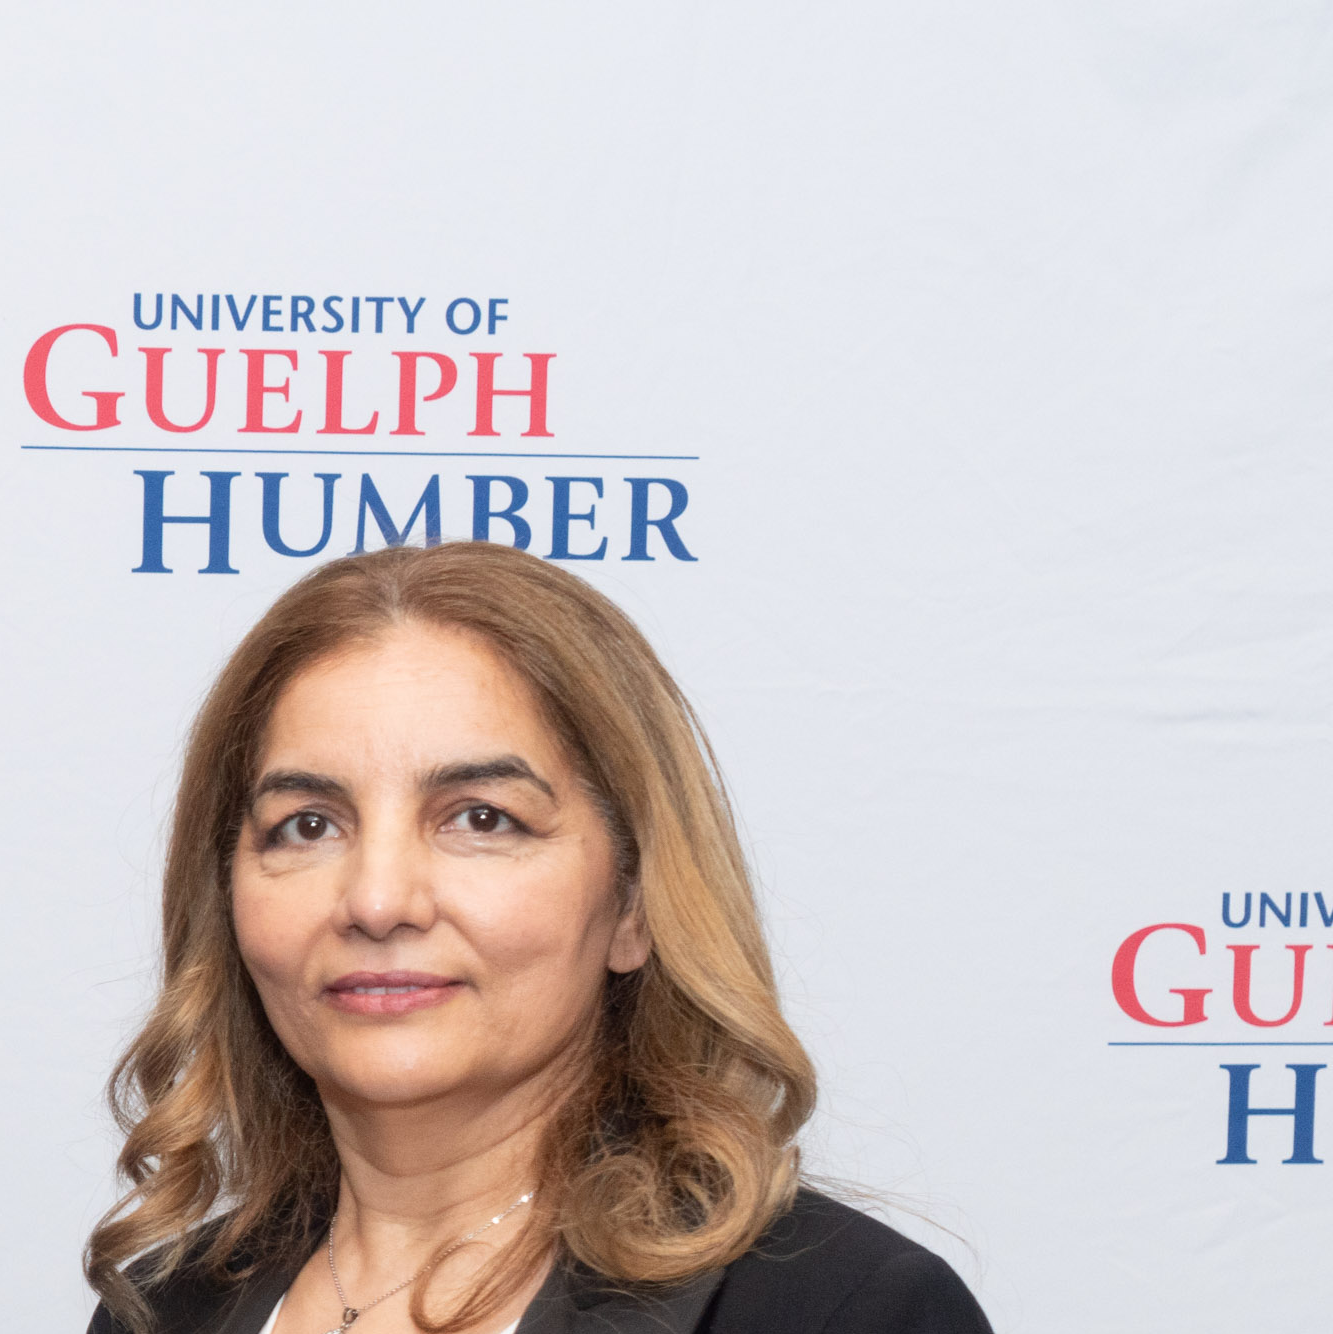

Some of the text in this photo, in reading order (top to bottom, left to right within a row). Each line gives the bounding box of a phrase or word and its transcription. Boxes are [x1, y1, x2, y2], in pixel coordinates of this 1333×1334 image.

[134, 293, 511, 337] UNIVERSITY OF
[23, 323, 557, 438] GUELPH
[132, 470, 700, 575] HUMBER
[1112, 923, 1333, 1028] GU
